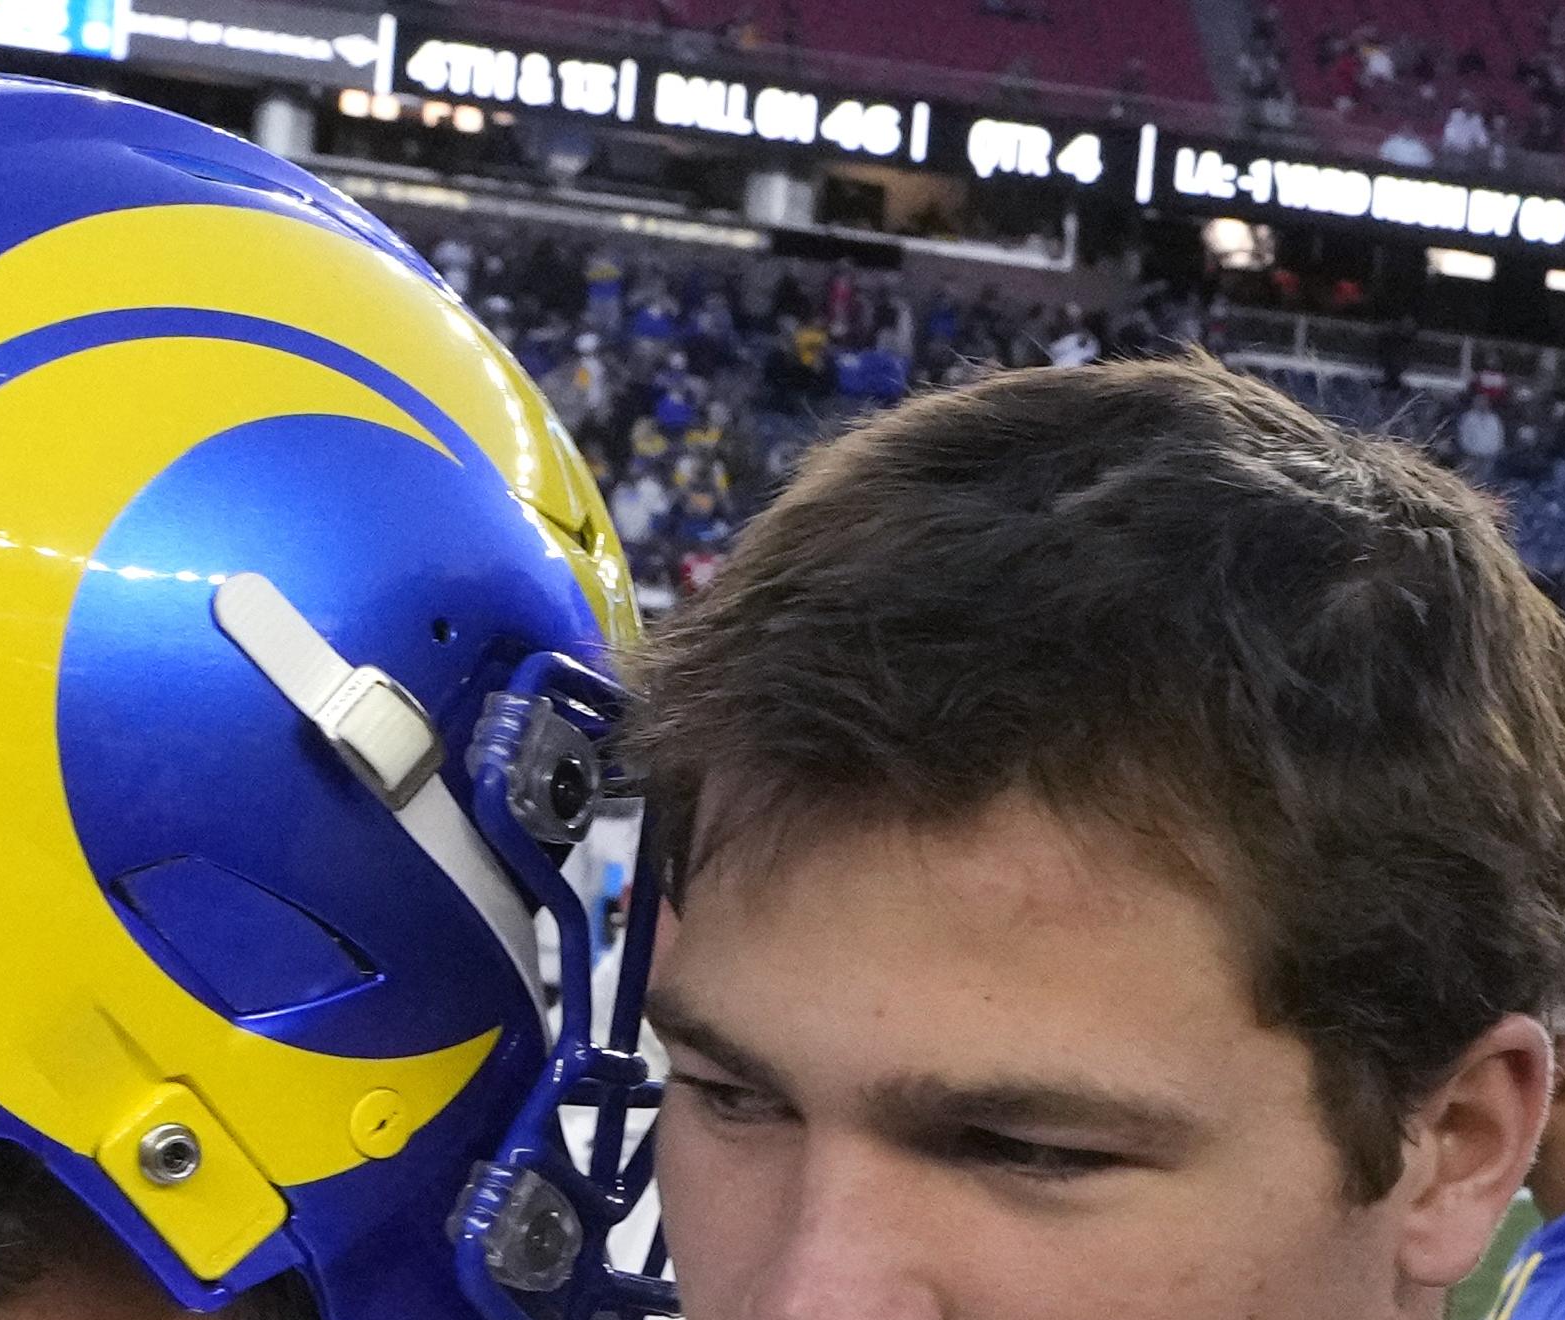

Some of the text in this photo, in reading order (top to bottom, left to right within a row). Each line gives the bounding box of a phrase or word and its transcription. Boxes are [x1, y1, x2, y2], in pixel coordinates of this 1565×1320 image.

[655, 73, 752, 134] BALL
[755, 88, 817, 142] ON
[968, 119, 1102, 183] QTR 4
